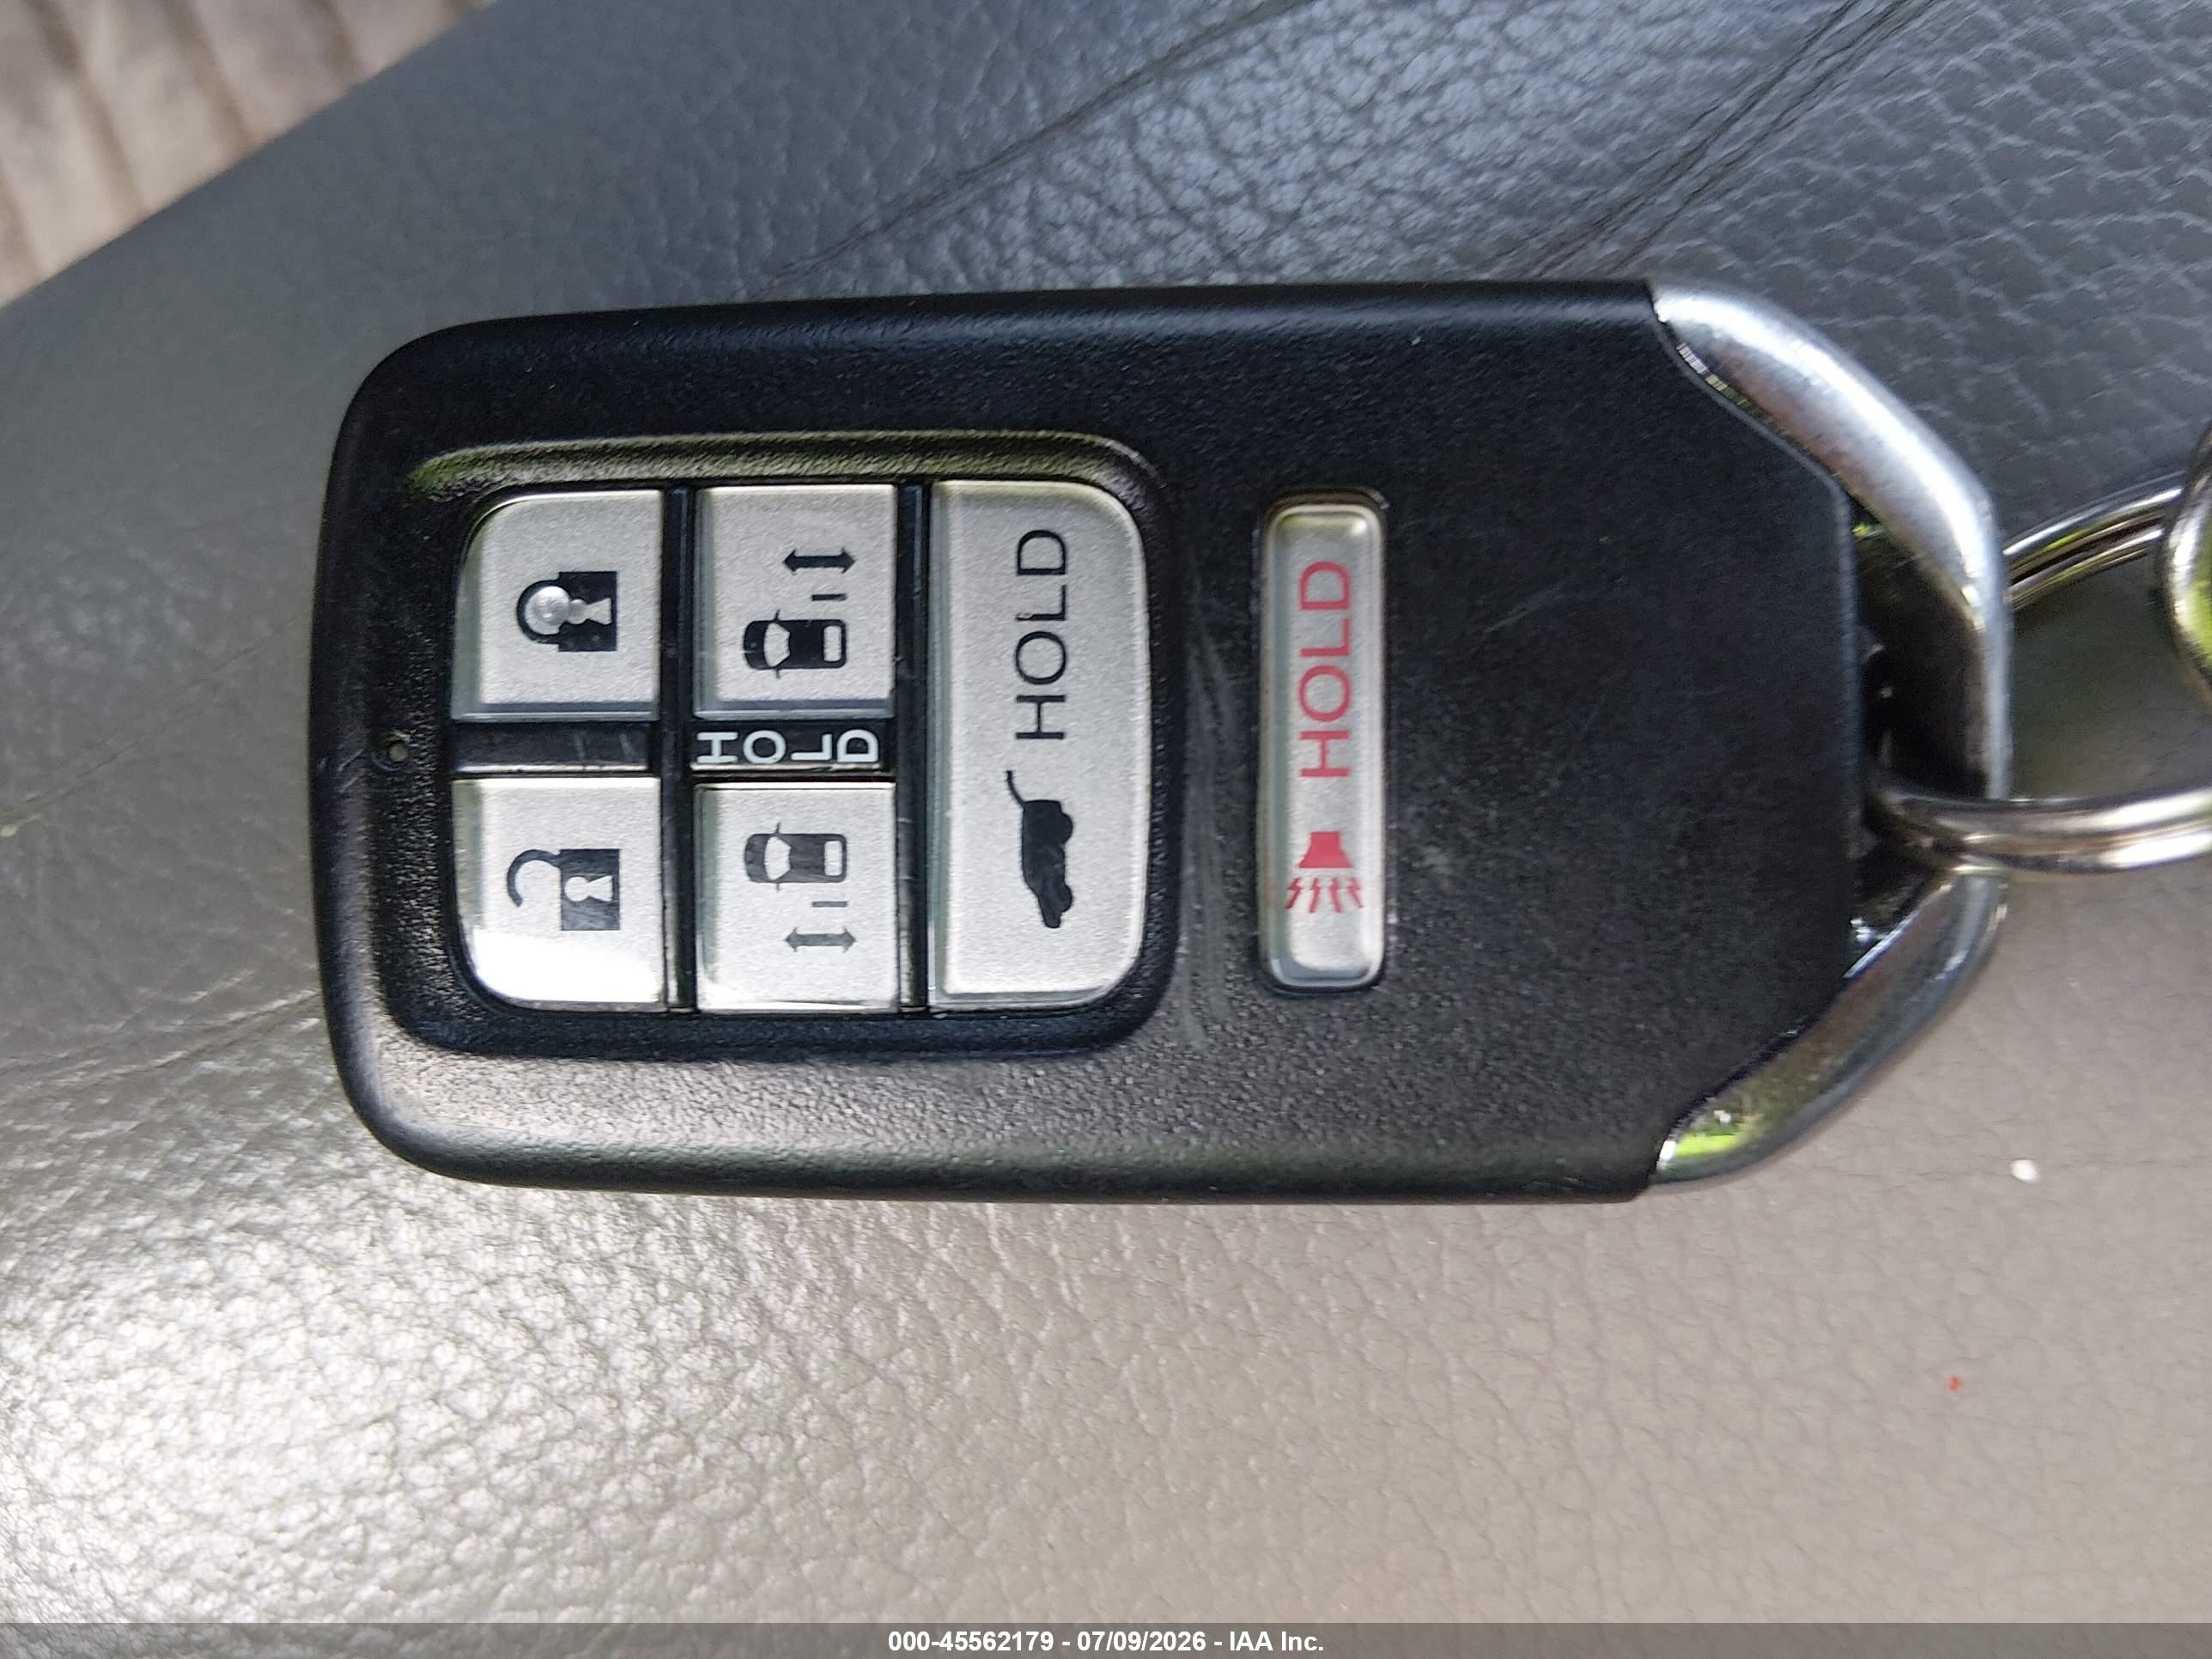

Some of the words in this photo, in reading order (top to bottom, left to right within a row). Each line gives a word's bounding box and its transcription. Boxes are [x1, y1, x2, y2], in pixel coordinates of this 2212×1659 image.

[1014, 529, 1068, 740] HOLD
[1297, 562, 1352, 779] HOLD
[696, 729, 879, 764] HOLD
